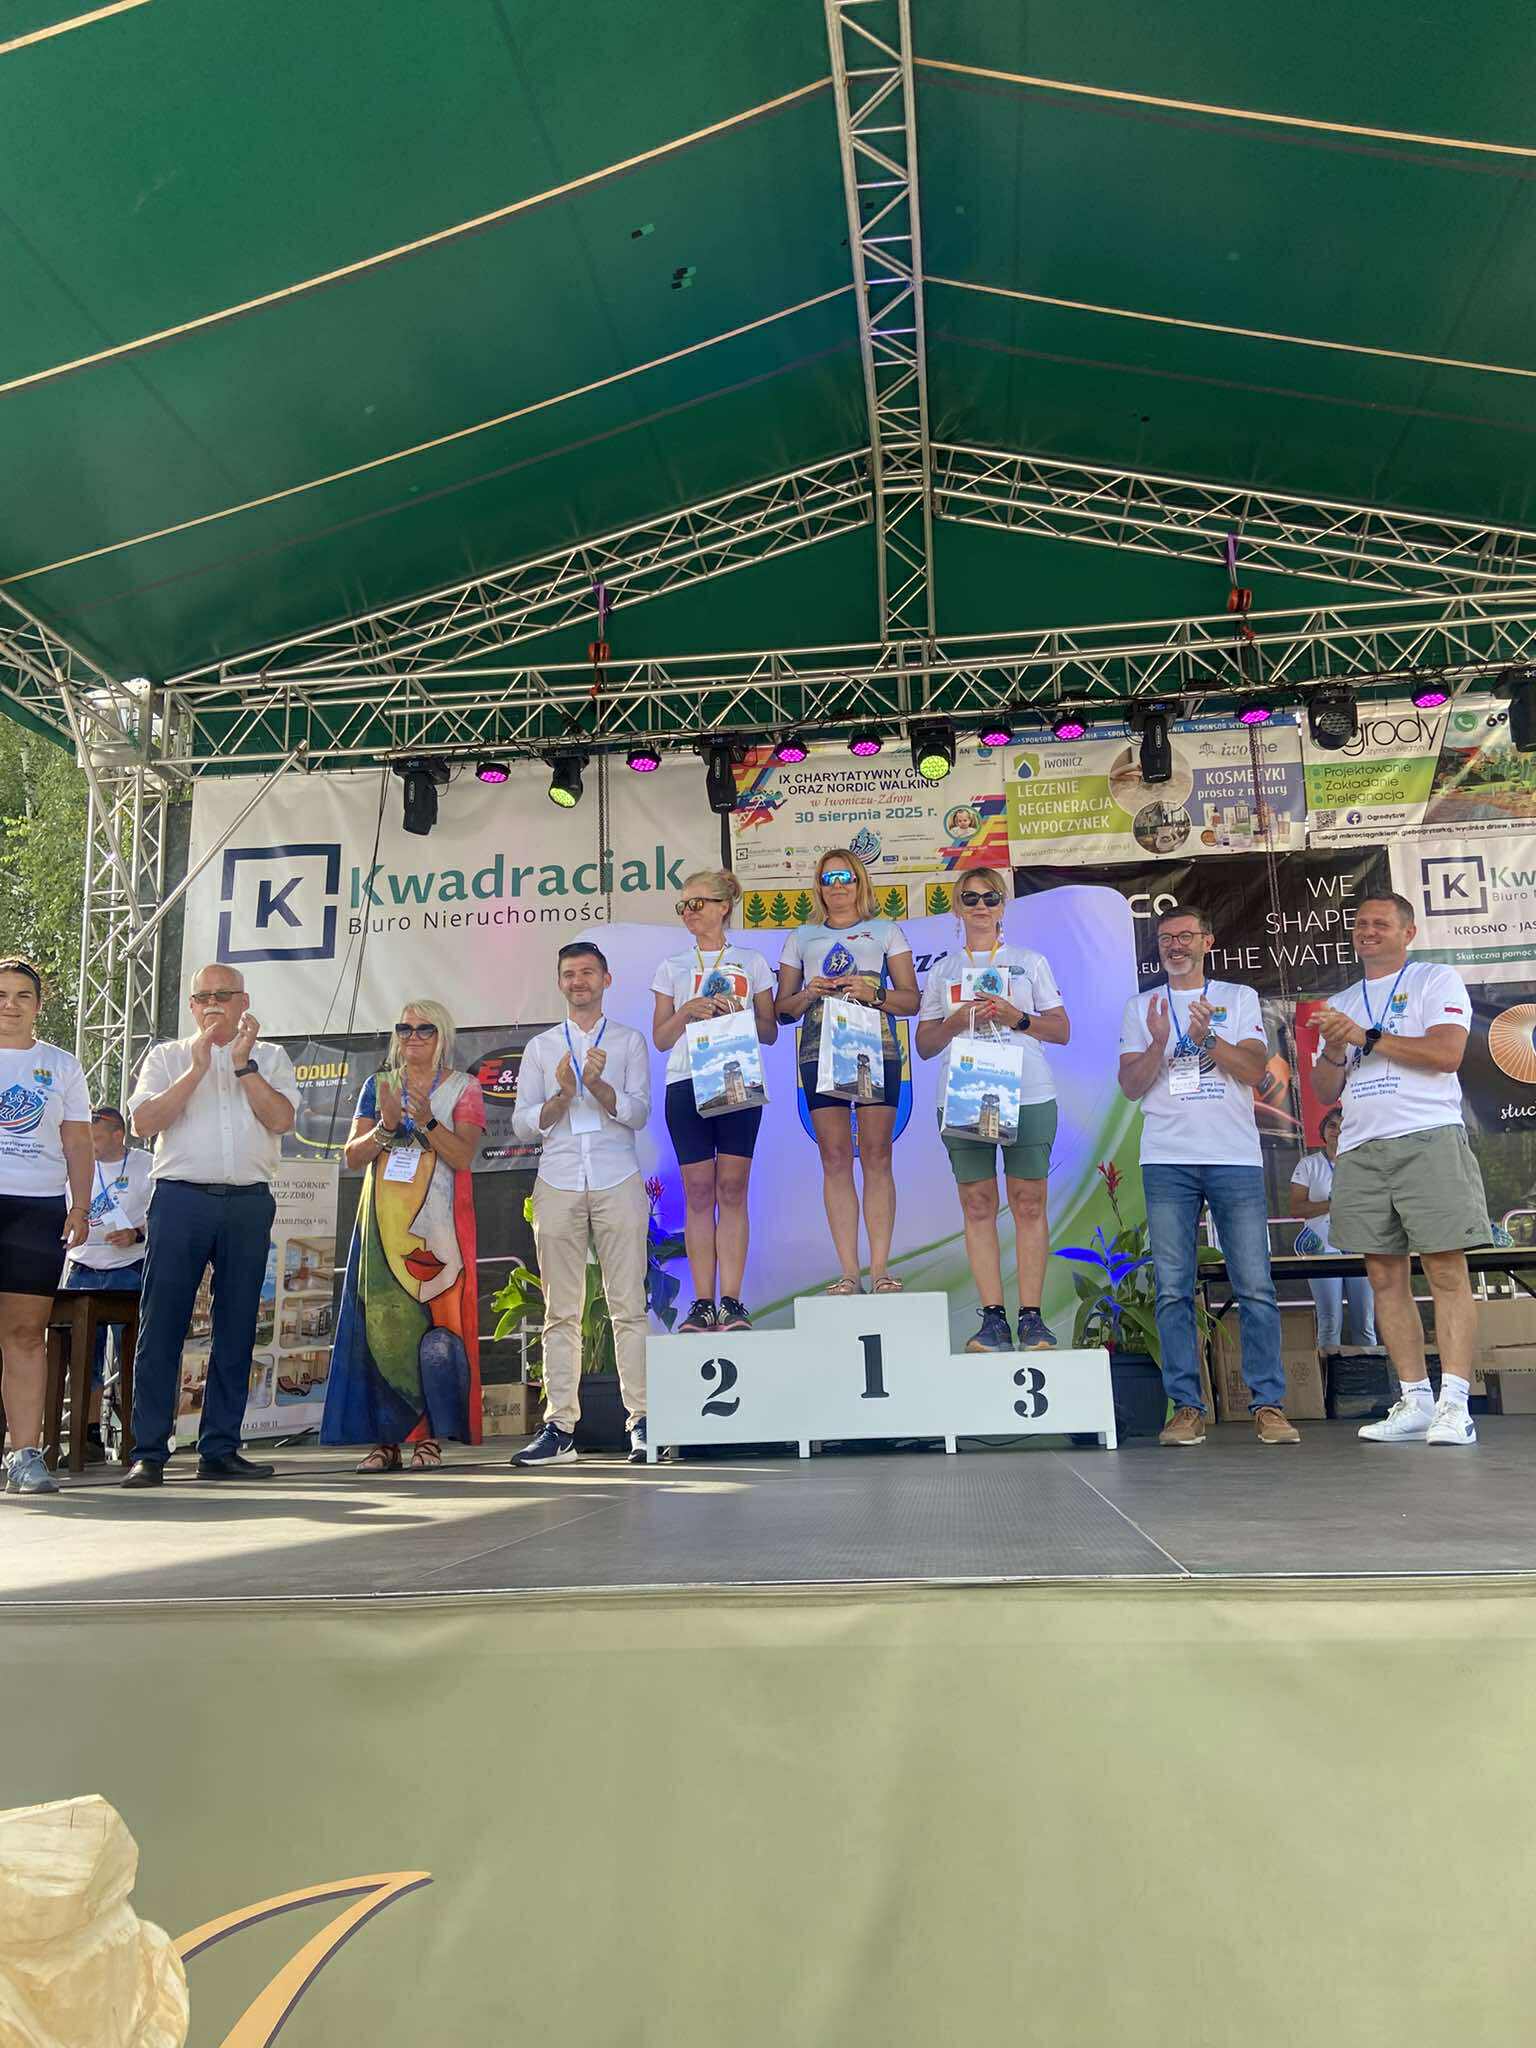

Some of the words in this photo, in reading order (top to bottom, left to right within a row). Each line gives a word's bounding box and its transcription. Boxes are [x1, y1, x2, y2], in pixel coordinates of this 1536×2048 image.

[1342, 711, 1441, 756] grody
[1044, 757, 1083, 768] IWONICZ
[1324, 763, 1412, 779] Projektowanie
[779, 774, 791, 785] IX
[795, 769, 900, 784] CHARYTATYWNY
[1206, 767, 1286, 785] KOSMETYKI
[1326, 777, 1400, 791] Zakładanie
[788, 784, 824, 796] ORAZ
[827, 782, 876, 794] NORDIC
[879, 779, 940, 791] WALKING
[1017, 782, 1080, 798] LECZENIE
[1197, 787, 1235, 800] prosto
[1247, 785, 1288, 797] ntury
[821, 794, 914, 807] Iwoniczu-Zdroju
[1327, 789, 1406, 805] Pielęgnacja
[794, 812, 815, 823] 30
[818, 809, 882, 825] sierpnia
[886, 807, 924, 819] 2025
[927, 808, 938, 817] r.
[1018, 799, 1114, 817] REGENERACJA
[1019, 815, 1110, 834] WYPOCZYNEK
[350, 845, 686, 909] Kwadraciak
[1442, 873, 1470, 899] K
[1306, 875, 1355, 898] WE
[256, 877, 303, 928] K
[1492, 891, 1529, 902] Biuro
[348, 912, 412, 936] Buro
[423, 902, 611, 930] Nieruchomośc
[1266, 908, 1358, 934] SHAPE
[1454, 922, 1508, 935] KROSNO
[1209, 947, 1262, 971] THE
[1268, 942, 1359, 967] WATE
[1456, 951, 1501, 961] Skuteczna
[1502, 950, 1532, 961] pomoc
[293, 1062, 349, 1081] ODULO
[857, 1333, 890, 1398] 1
[700, 1358, 740, 1417] 2
[1013, 1366, 1049, 1419] 3
